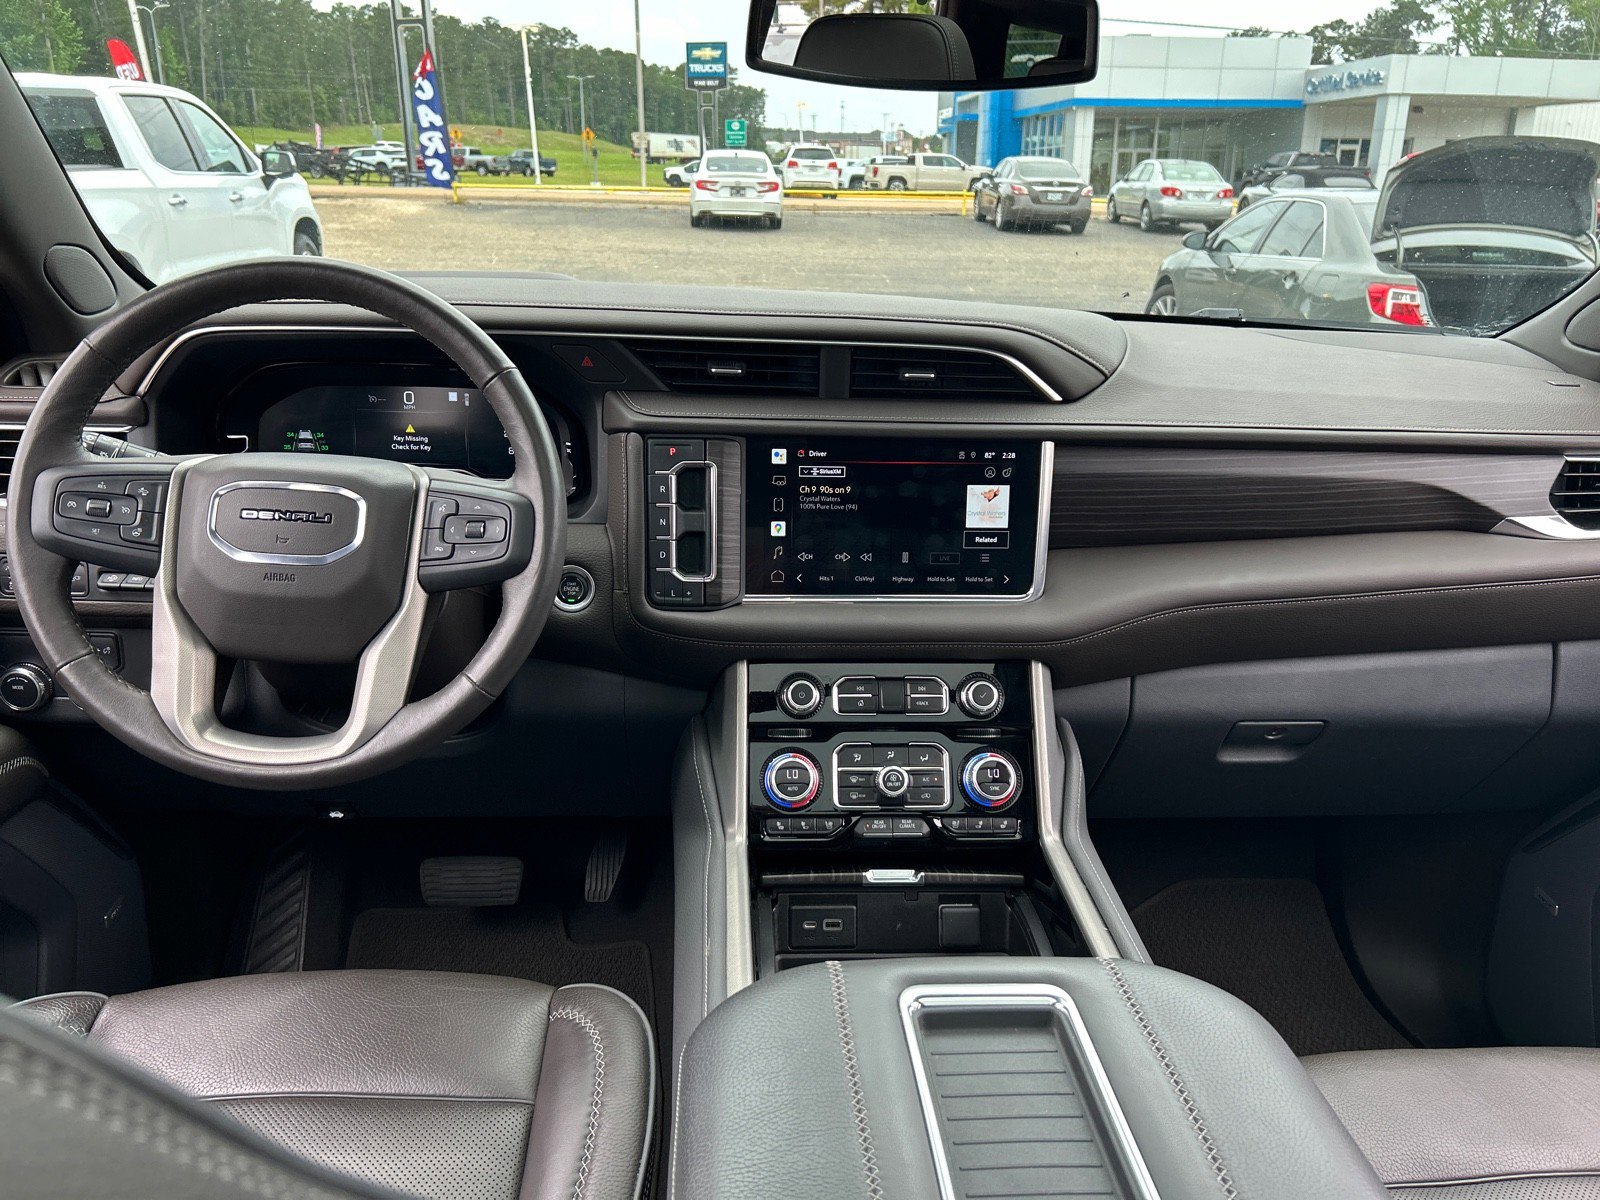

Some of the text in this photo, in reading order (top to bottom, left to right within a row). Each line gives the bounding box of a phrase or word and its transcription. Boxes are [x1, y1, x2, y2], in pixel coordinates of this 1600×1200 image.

[689, 64, 724, 73] TRUCKS
[403, 391, 415, 405] 0
[393, 435, 429, 444] Key Missing
[669, 447, 676, 456] P
[984, 451, 996, 459] 82°
[659, 485, 666, 493] R
[800, 485, 851, 494] Ch 9 90s on 9
[800, 495, 820, 503] Crystal
[845, 503, 858, 511] (94)
[240, 508, 333, 524] DENALI
[659, 519, 666, 527] N
[263, 572, 296, 583] AIRBAG
[854, 575, 875, 583] ClsVinyl
[892, 576, 914, 584] Highway
[786, 769, 799, 779] LO
[987, 768, 1000, 778] LO
